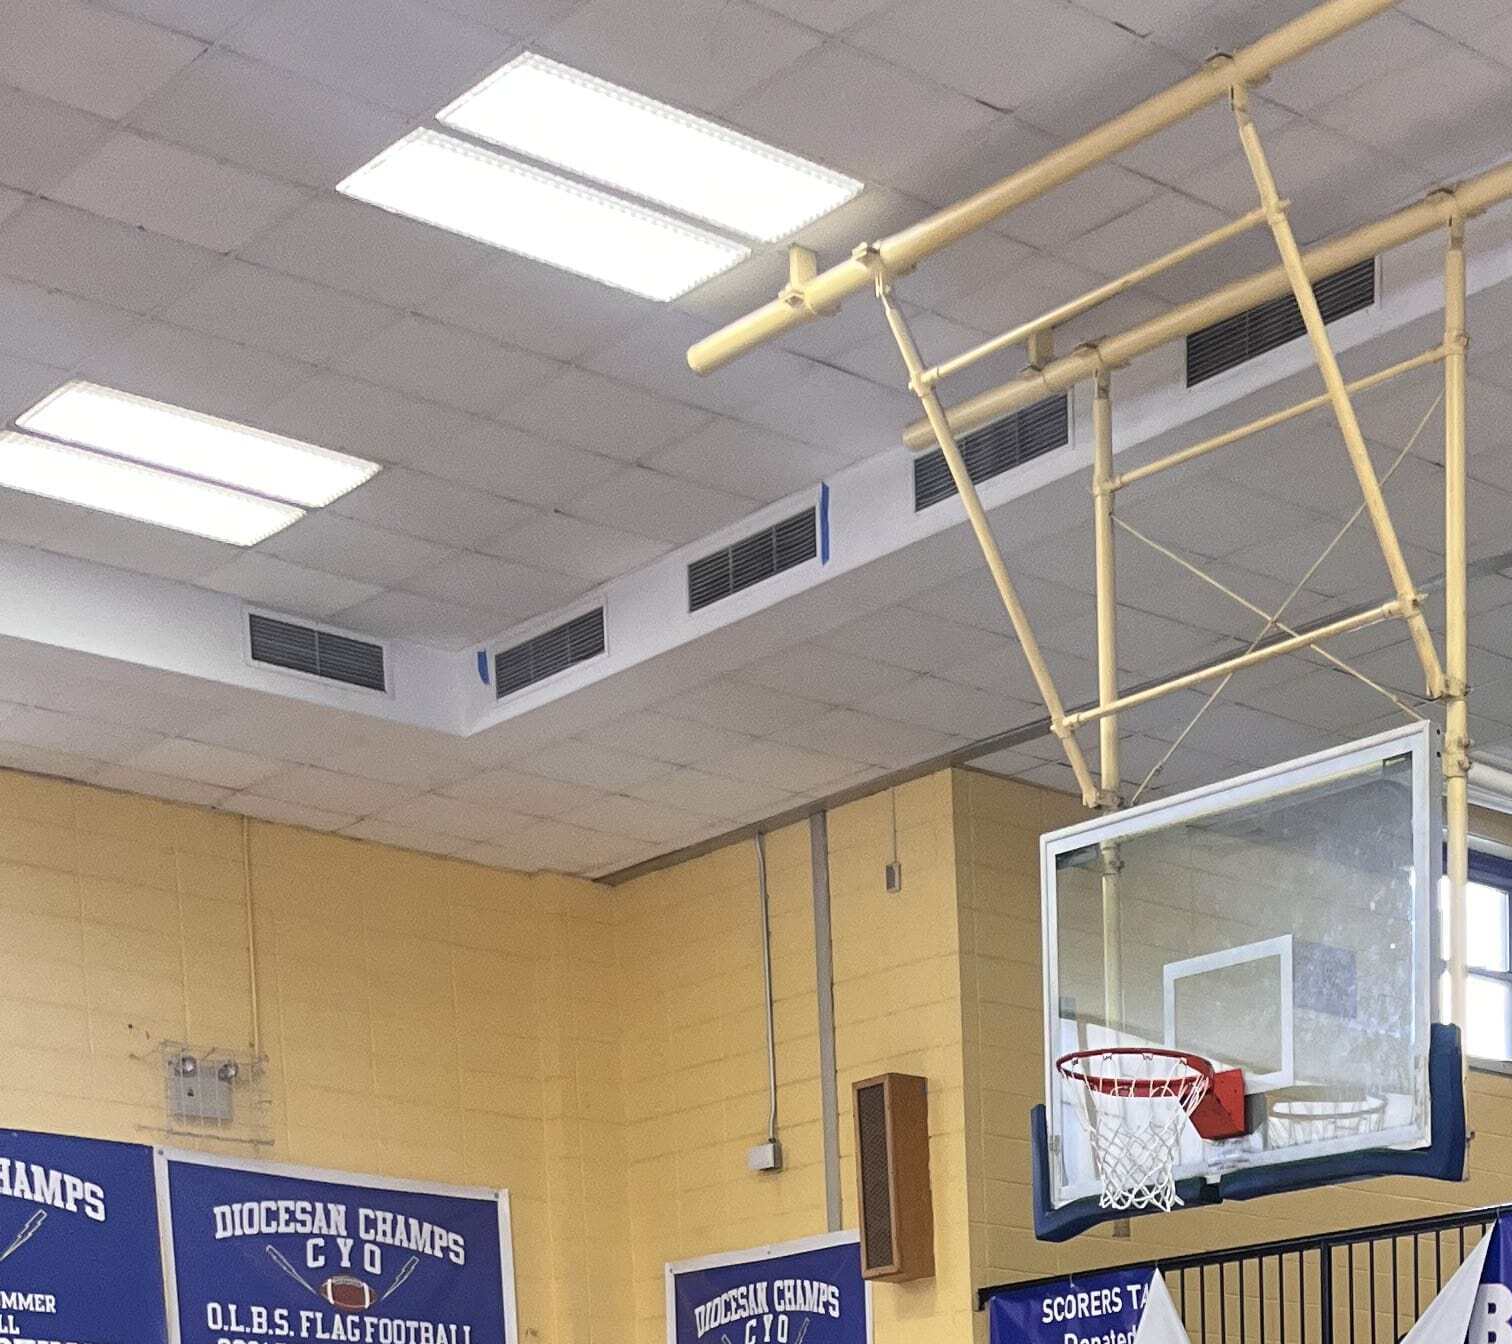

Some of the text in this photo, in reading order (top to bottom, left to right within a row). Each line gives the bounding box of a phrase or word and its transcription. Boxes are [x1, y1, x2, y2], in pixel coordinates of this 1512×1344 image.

[213, 1200, 466, 1266] DIOCESAN CHAMPS
[0, 1292, 56, 1320] MMER
[207, 1302, 295, 1338] O.L.B.S.
[300, 1309, 360, 1343] FLAG
[694, 1279, 840, 1339] DIOCESAN CHAMPS
[1041, 1286, 1123, 1323] SCORERS
